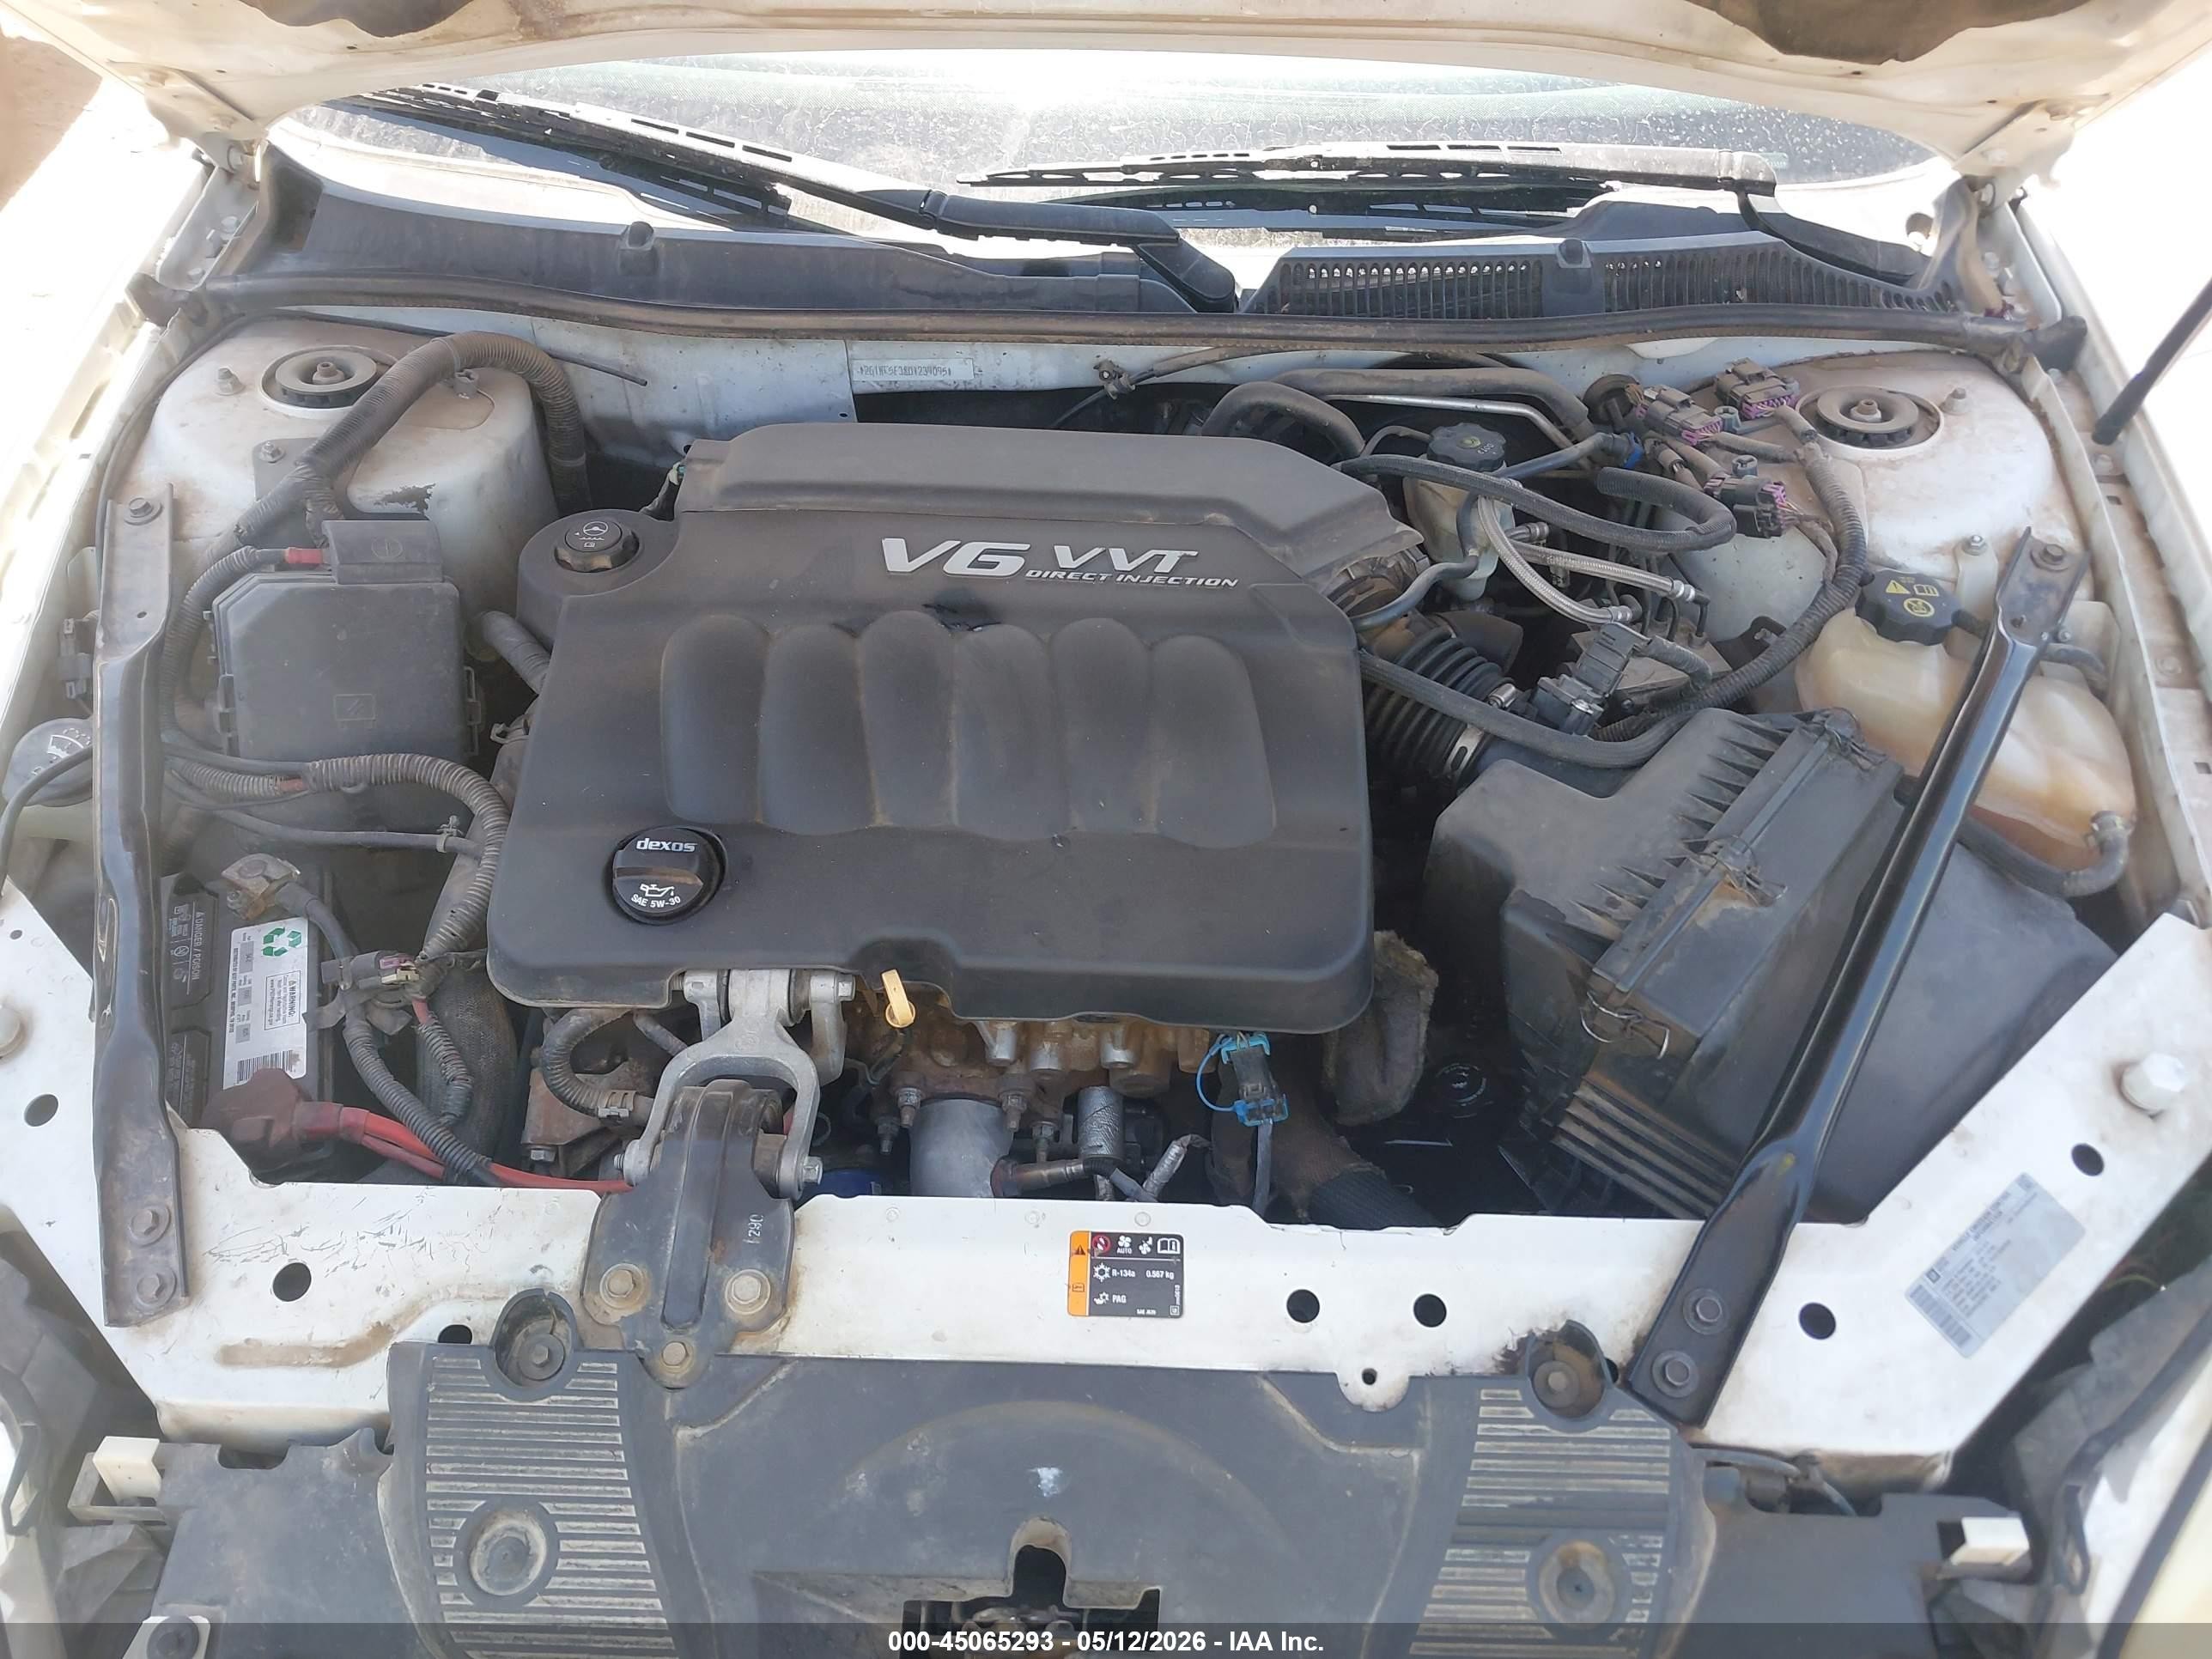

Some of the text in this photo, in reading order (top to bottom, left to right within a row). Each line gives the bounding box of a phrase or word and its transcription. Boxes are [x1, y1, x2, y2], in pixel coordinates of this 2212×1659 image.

[882, 538, 1199, 578] V6 VVT
[1025, 569, 1239, 587] DIRECT INJECTION
[636, 838, 698, 852] dexos
[631, 894, 681, 908] SAE 5W-30
[193, 919, 204, 946] DANGER
[191, 954, 202, 981] POISON
[1111, 1269, 1135, 1278] R-134a
[1165, 1271, 1174, 1279] kg
[1112, 1295, 1127, 1304] PAG
